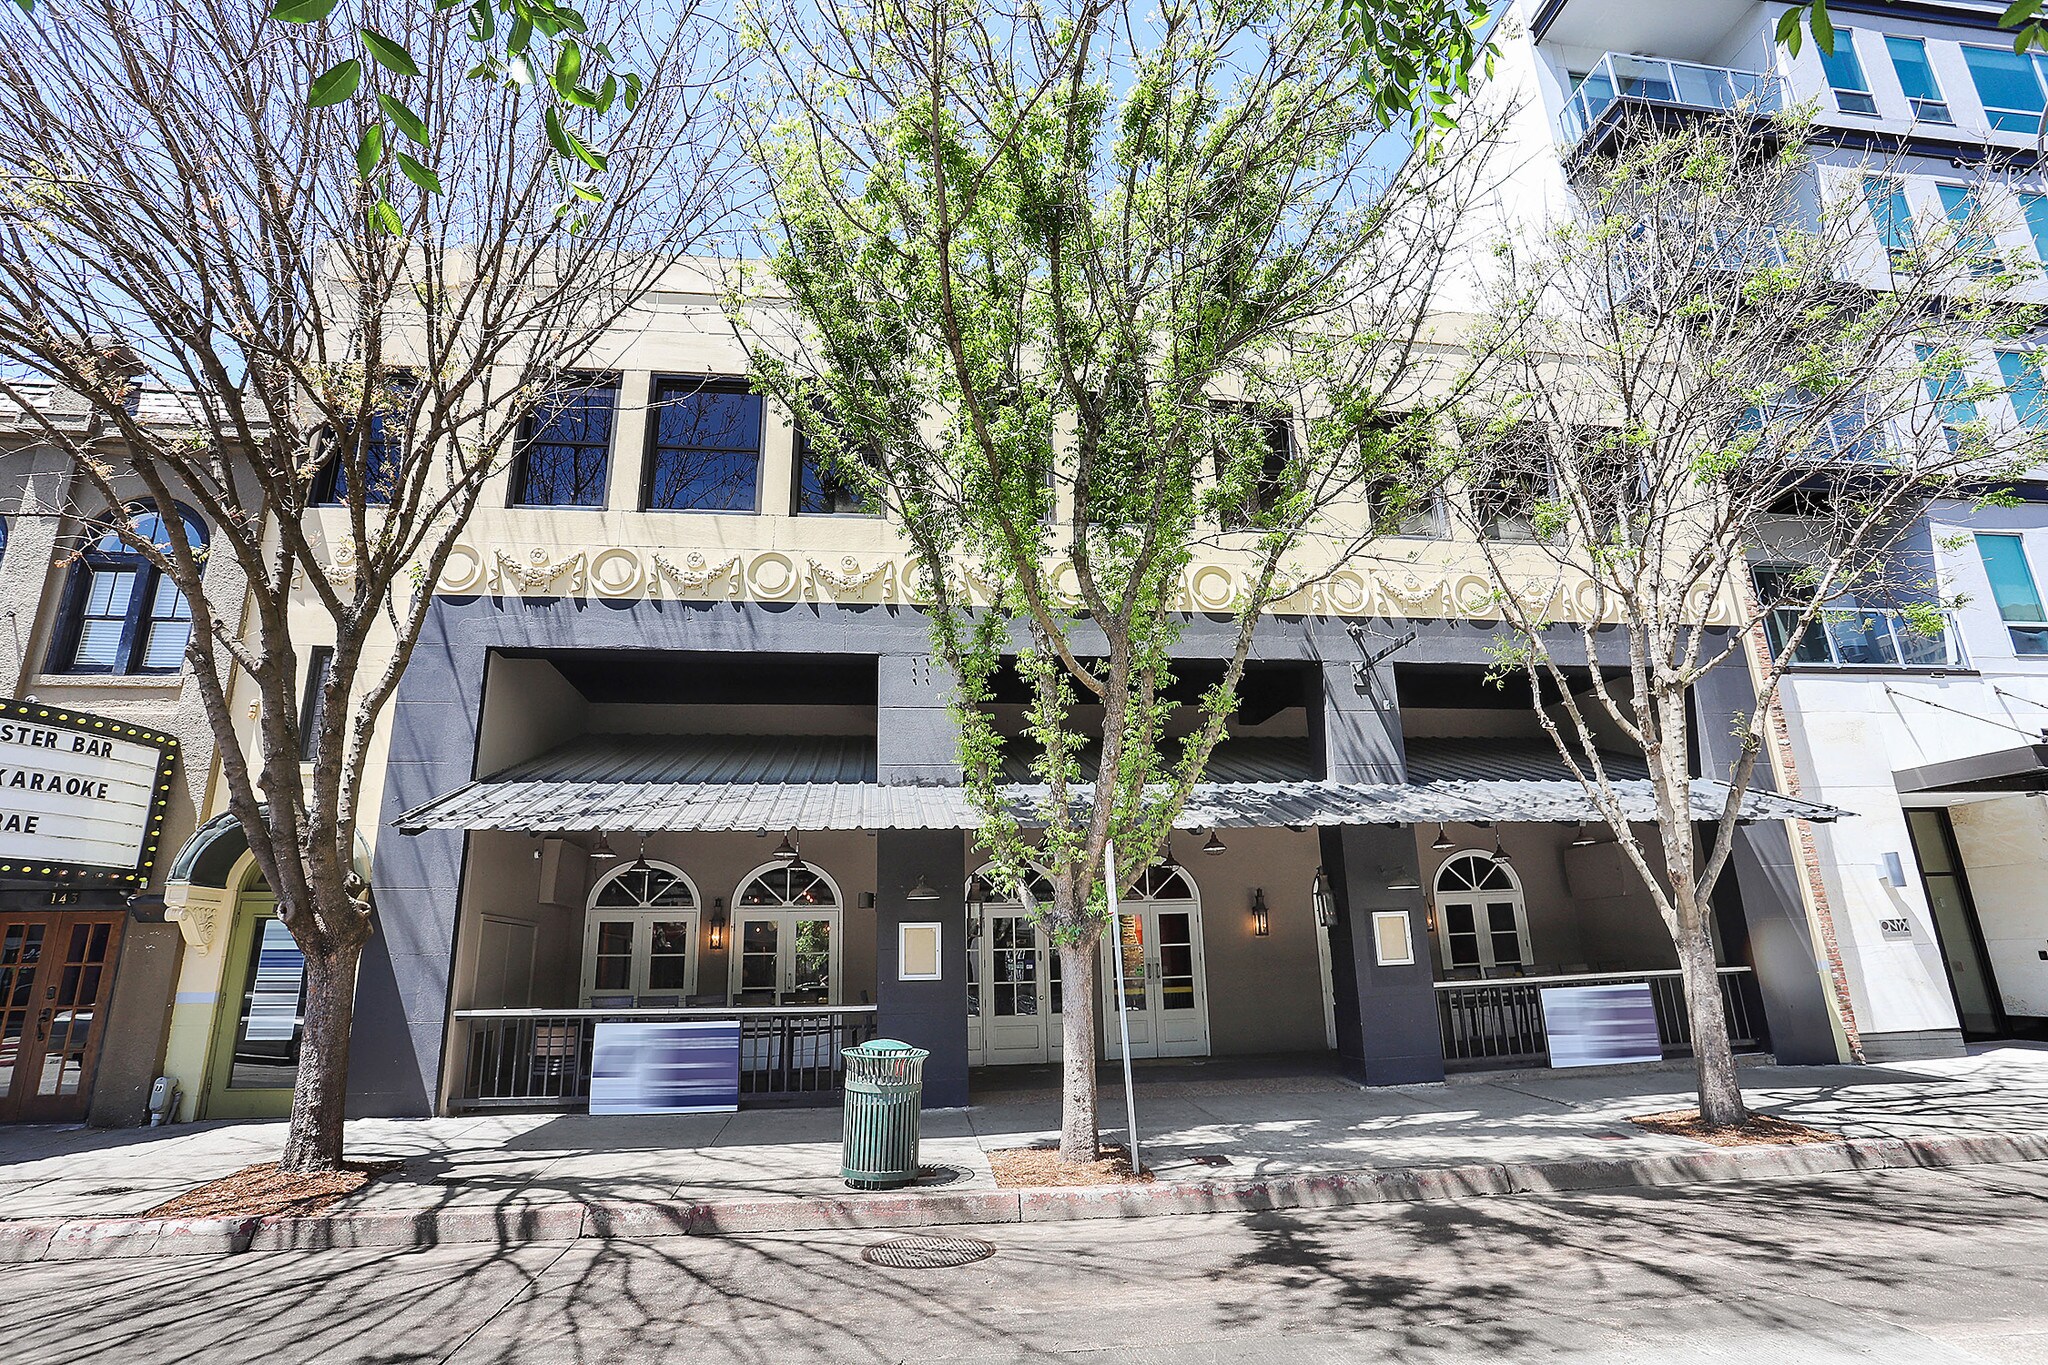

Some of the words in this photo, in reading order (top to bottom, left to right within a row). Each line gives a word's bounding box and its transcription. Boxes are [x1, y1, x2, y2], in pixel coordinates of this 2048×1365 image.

[1, 725, 57, 748] STER
[72, 736, 112, 758] BAR
[0, 813, 39, 833] AE
[1880, 918, 1910, 932] ONYX
